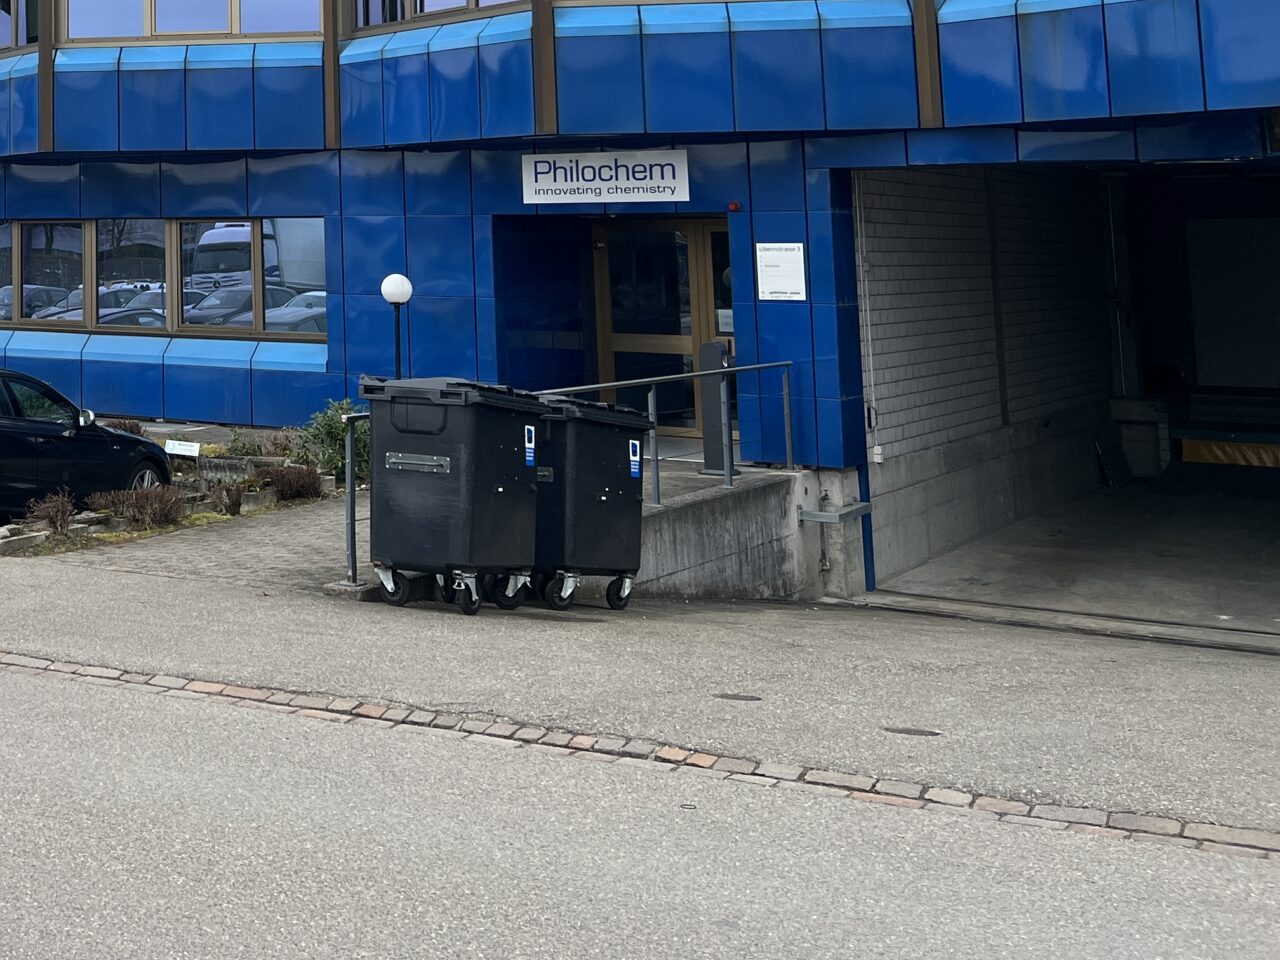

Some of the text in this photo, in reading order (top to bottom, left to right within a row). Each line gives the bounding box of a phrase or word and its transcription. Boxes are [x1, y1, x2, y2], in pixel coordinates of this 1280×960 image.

[533, 158, 676, 183] Philochem
[534, 184, 677, 197] innovating chemistry
